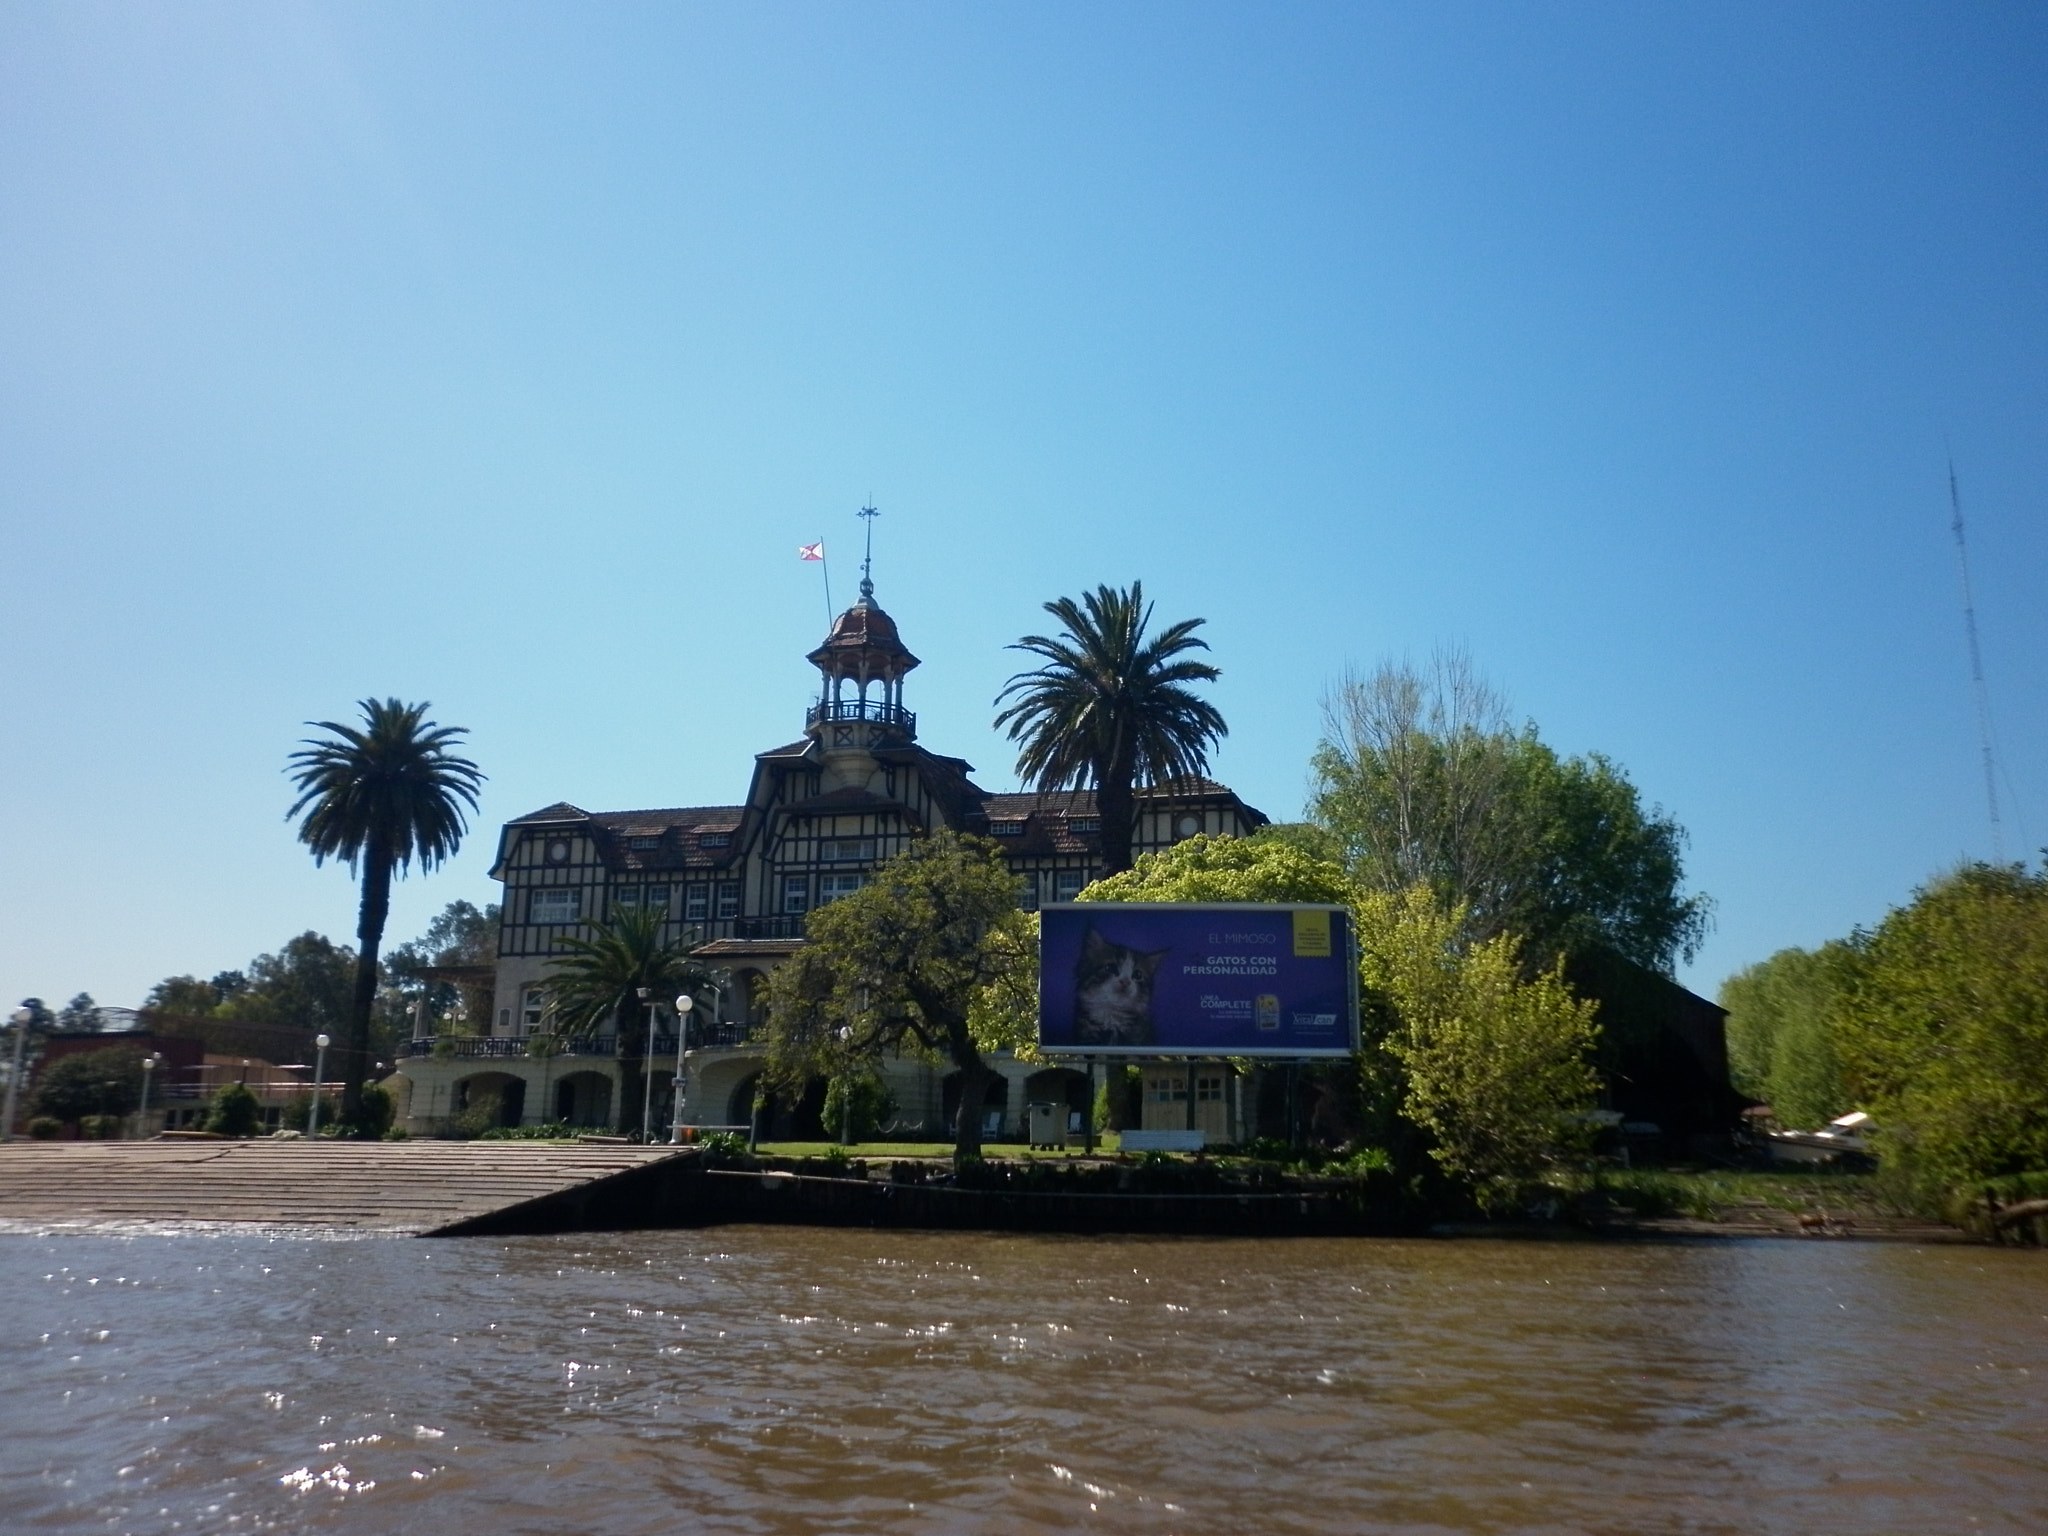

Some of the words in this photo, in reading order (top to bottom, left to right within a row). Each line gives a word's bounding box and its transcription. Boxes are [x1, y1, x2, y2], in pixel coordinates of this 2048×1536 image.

[1209, 933, 1221, 944] EL
[1225, 933, 1276, 944] MIMOSO
[1207, 956, 1246, 965] GATOS
[1250, 956, 1277, 965] CON
[1183, 966, 1277, 975] PERSONALIDAD
[1200, 1000, 1252, 1009] COMPLETE
